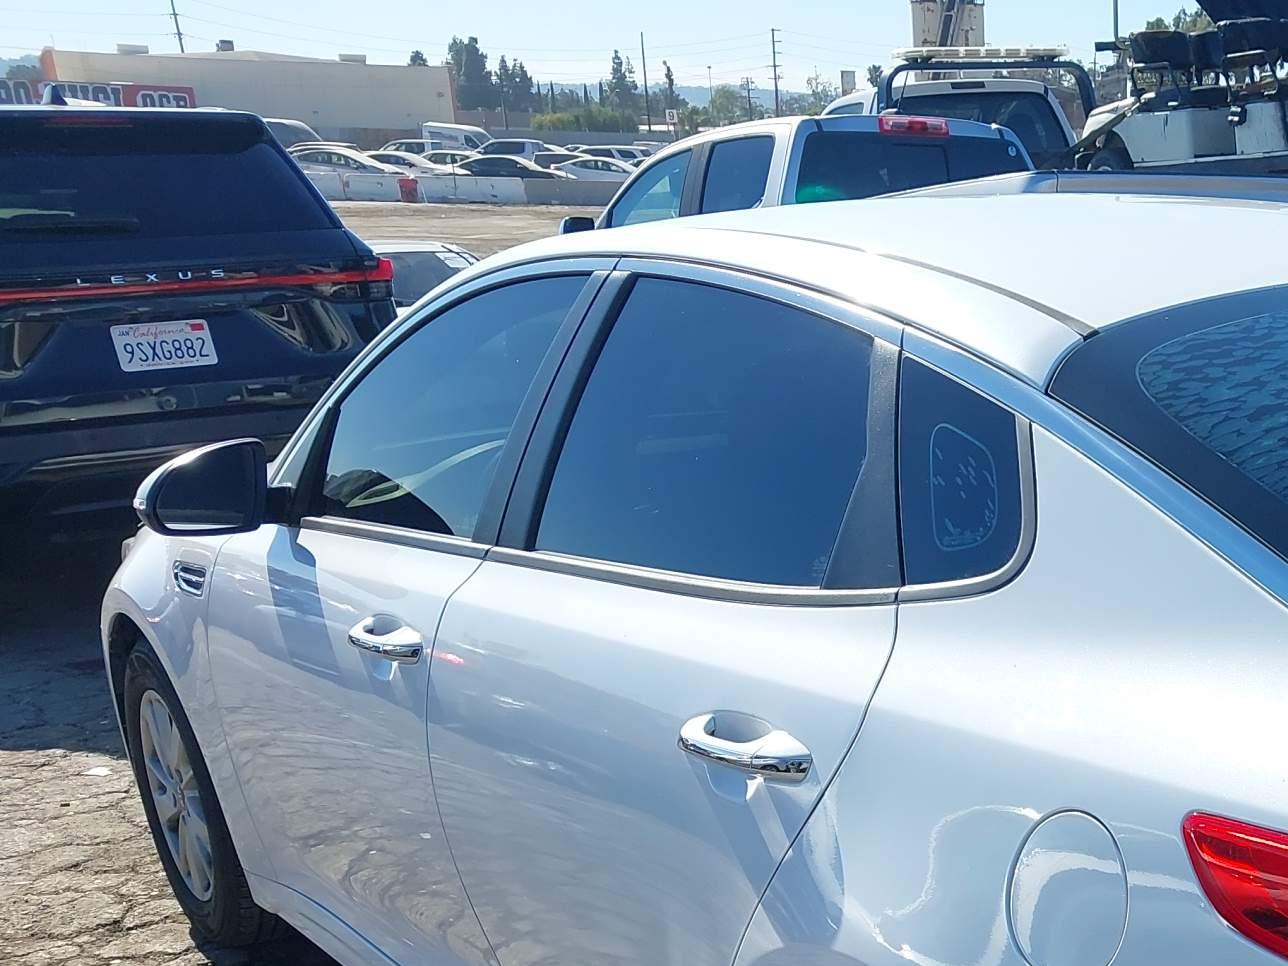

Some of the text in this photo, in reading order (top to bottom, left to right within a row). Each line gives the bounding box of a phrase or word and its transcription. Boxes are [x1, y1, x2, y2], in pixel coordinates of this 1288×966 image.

[668, 110, 675, 121] 9
[76, 268, 225, 287] LEXUS
[123, 336, 210, 364] 9SXG882
